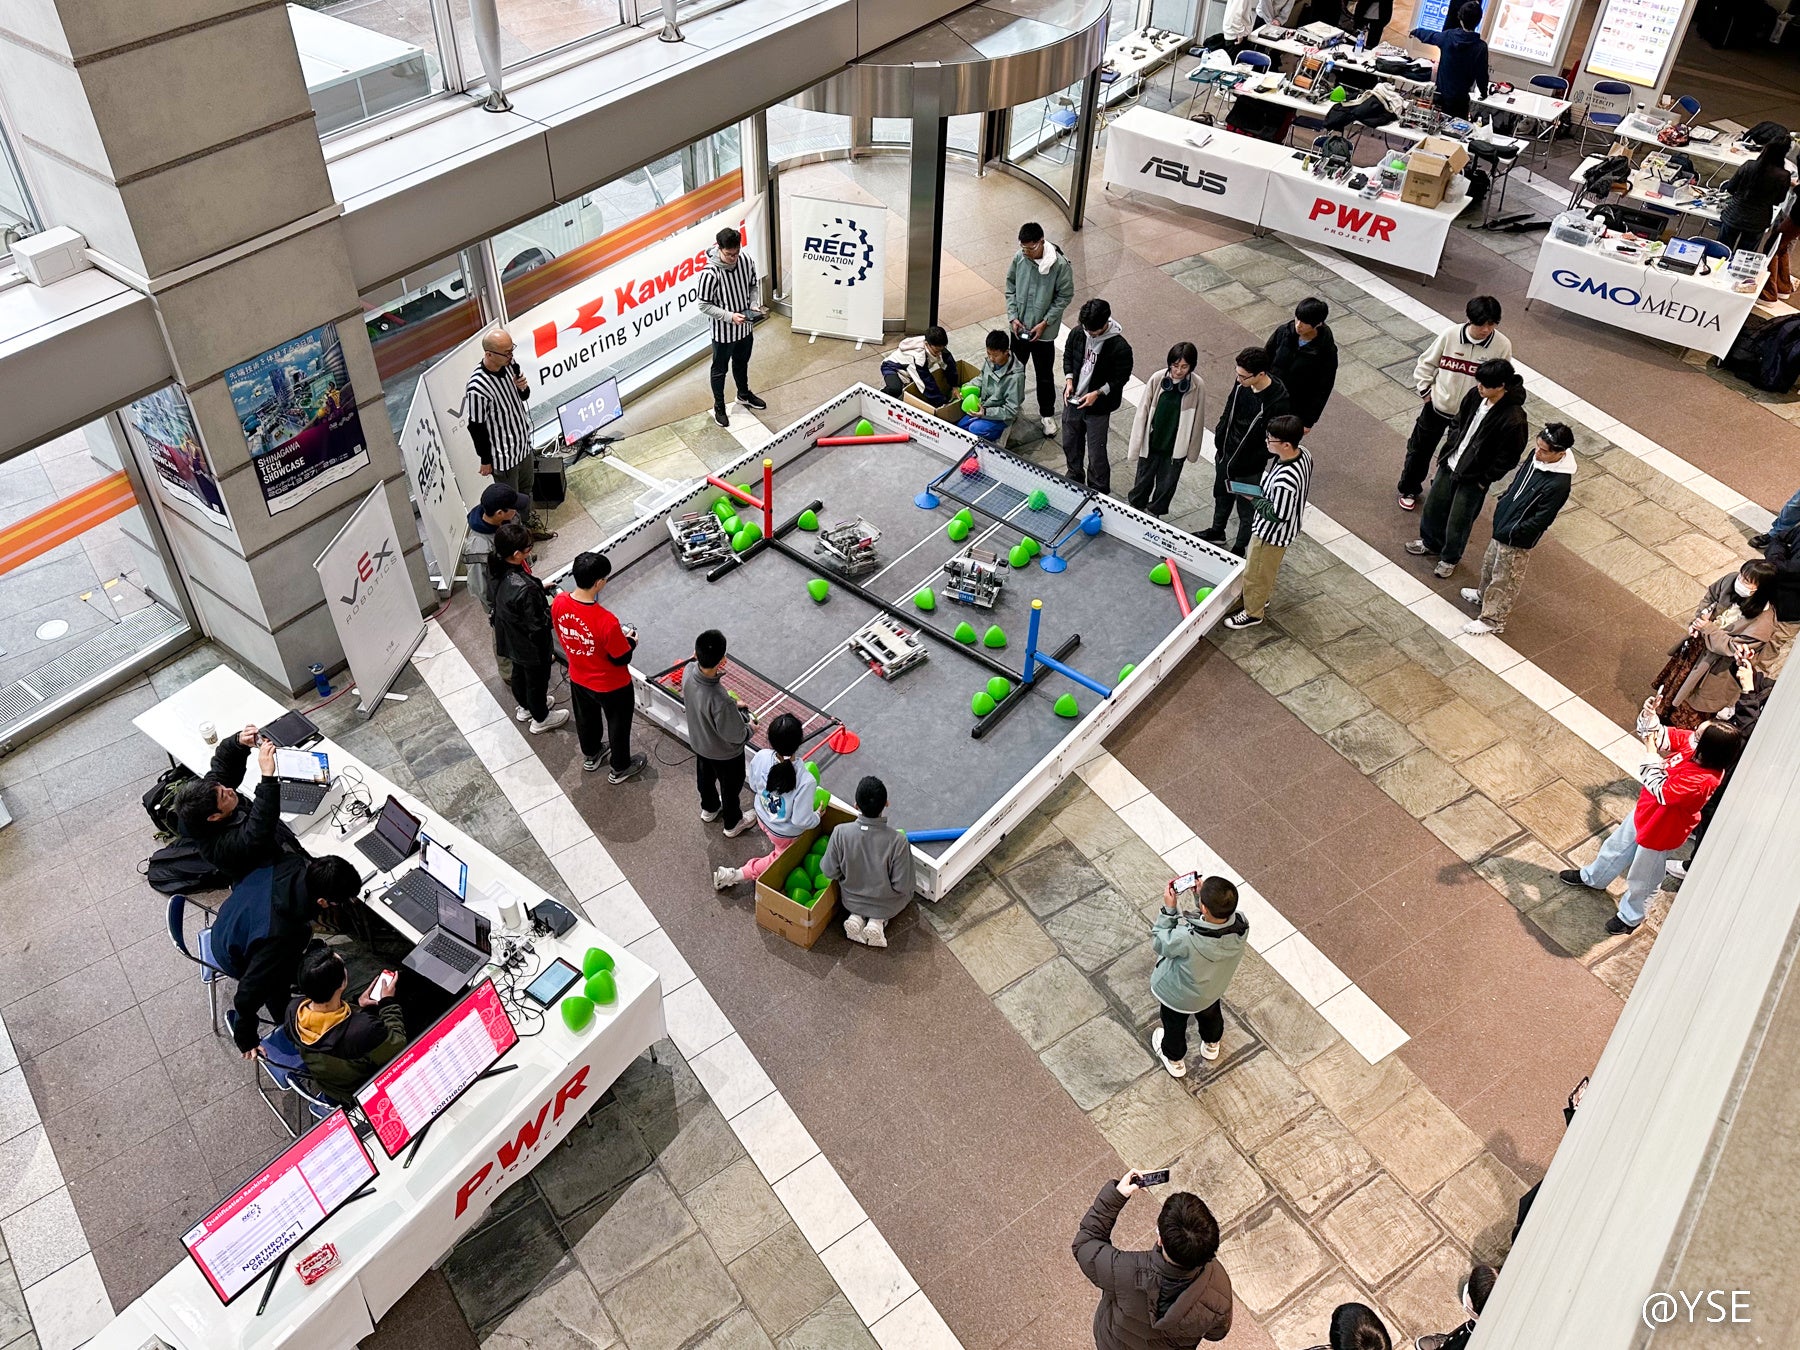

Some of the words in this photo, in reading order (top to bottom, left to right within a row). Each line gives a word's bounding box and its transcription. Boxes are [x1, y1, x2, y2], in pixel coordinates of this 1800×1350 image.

[1140, 156, 1228, 195] ASUS
[1308, 197, 1397, 242] PWR
[1323, 227, 1372, 244] PROJECT
[802, 252, 855, 266] FOUNDATION
[804, 236, 857, 258] REC
[614, 219, 748, 316] Kawasi
[1551, 269, 1641, 306] GMO
[1641, 295, 1721, 332] MEDIA
[538, 325, 628, 386] Powering
[632, 300, 672, 338] your
[577, 397, 605, 422] 1:19
[803, 421, 825, 440] ASUS
[905, 417, 940, 439] Kawasaki
[257, 441, 301, 468] SHINAGAWA
[260, 460, 282, 476] TECH
[263, 456, 306, 484] SHOWCASE
[418, 441, 435, 494] REC
[1144, 531, 1160, 542] AVC
[340, 537, 395, 606] VEX
[346, 556, 398, 625] ROBOTICS
[769, 909, 793, 926] VEX
[376, 1070, 392, 1088] Match
[391, 1052, 415, 1075] Schedule
[431, 1080, 468, 1116] NORTHROP
[326, 1113, 344, 1127] VEX
[455, 1065, 591, 1220] PWR
[484, 1118, 562, 1196] PROJECT
[206, 1195, 244, 1227] Qualification
[243, 1173, 271, 1198] Rankings
[241, 1208, 257, 1223] REC
[242, 1231, 288, 1272] NORTHROP
[251, 1231, 297, 1272] GRUMMAN
